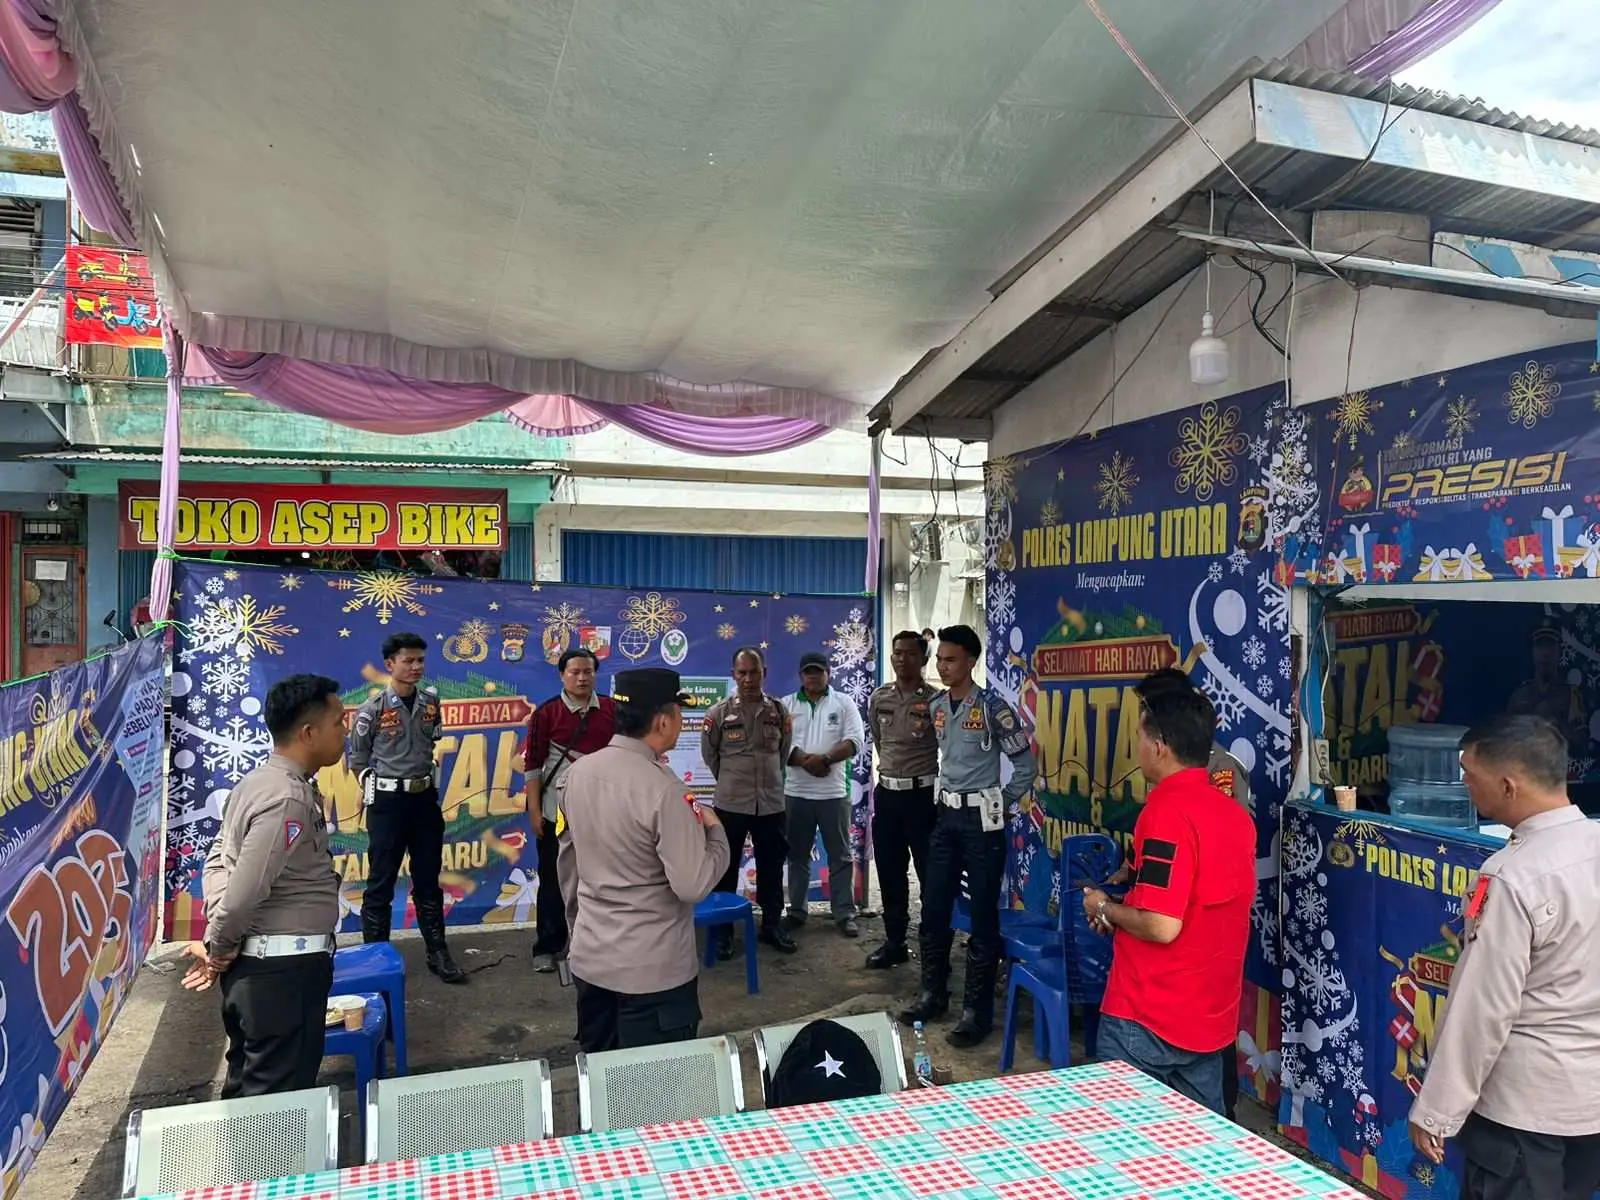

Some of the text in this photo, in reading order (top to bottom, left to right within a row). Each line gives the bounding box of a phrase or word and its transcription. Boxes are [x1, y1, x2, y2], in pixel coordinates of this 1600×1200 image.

[1428, 451, 1460, 467] POLRI
[1463, 446, 1493, 463] YANG
[1382, 451, 1568, 502] PRESISI
[1521, 482, 1572, 496] BERKEADILAN
[270, 499, 388, 545] ASEP
[397, 500, 501, 546] BIKE
[1023, 502, 1227, 568] POLRES LAMPUNG UTARA
[1075, 569, 1146, 593] Mengucapkan:
[1343, 614, 1404, 637] HARI RAYA
[1044, 644, 1160, 674] SELAMAT HARI RAYA
[441, 702, 511, 725] ARI RAYA
[1035, 686, 1149, 804] NATA
[441, 840, 488, 870] ARU
[1366, 844, 1436, 890] POLRES
